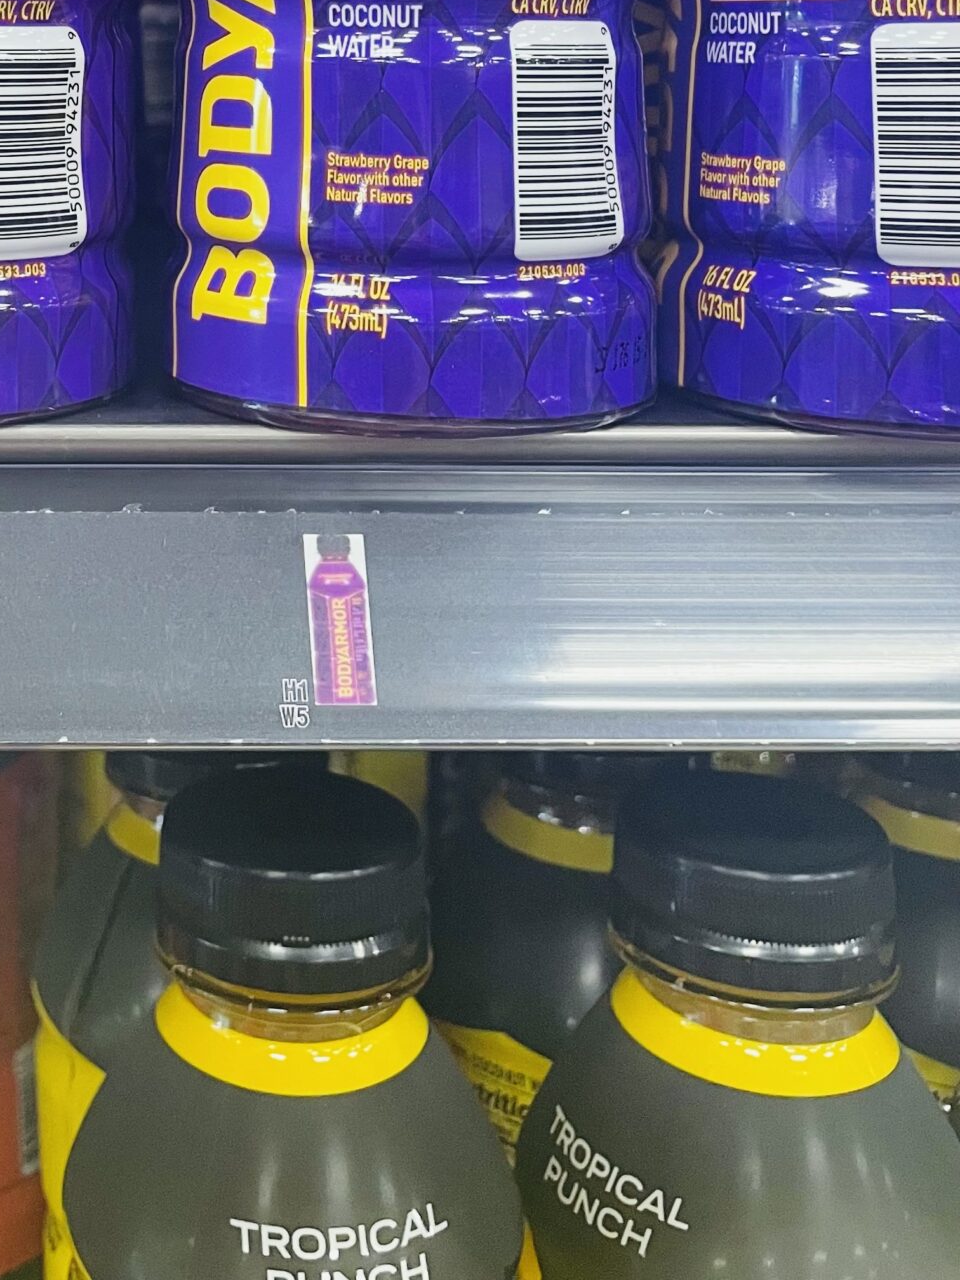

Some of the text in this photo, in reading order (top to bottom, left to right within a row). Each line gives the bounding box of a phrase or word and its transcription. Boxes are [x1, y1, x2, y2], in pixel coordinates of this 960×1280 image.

[328, 4, 422, 29] COCONUT
[710, 11, 781, 35] COCONUT
[707, 41, 756, 65] WATER
[332, 598, 354, 698] BODYARMOR
[282, 679, 309, 703] H1
[279, 704, 310, 728] W5
[549, 1104, 689, 1231] TROPICAL
[544, 1155, 652, 1258] PUNCH
[230, 1203, 448, 1261] TROPICAL
